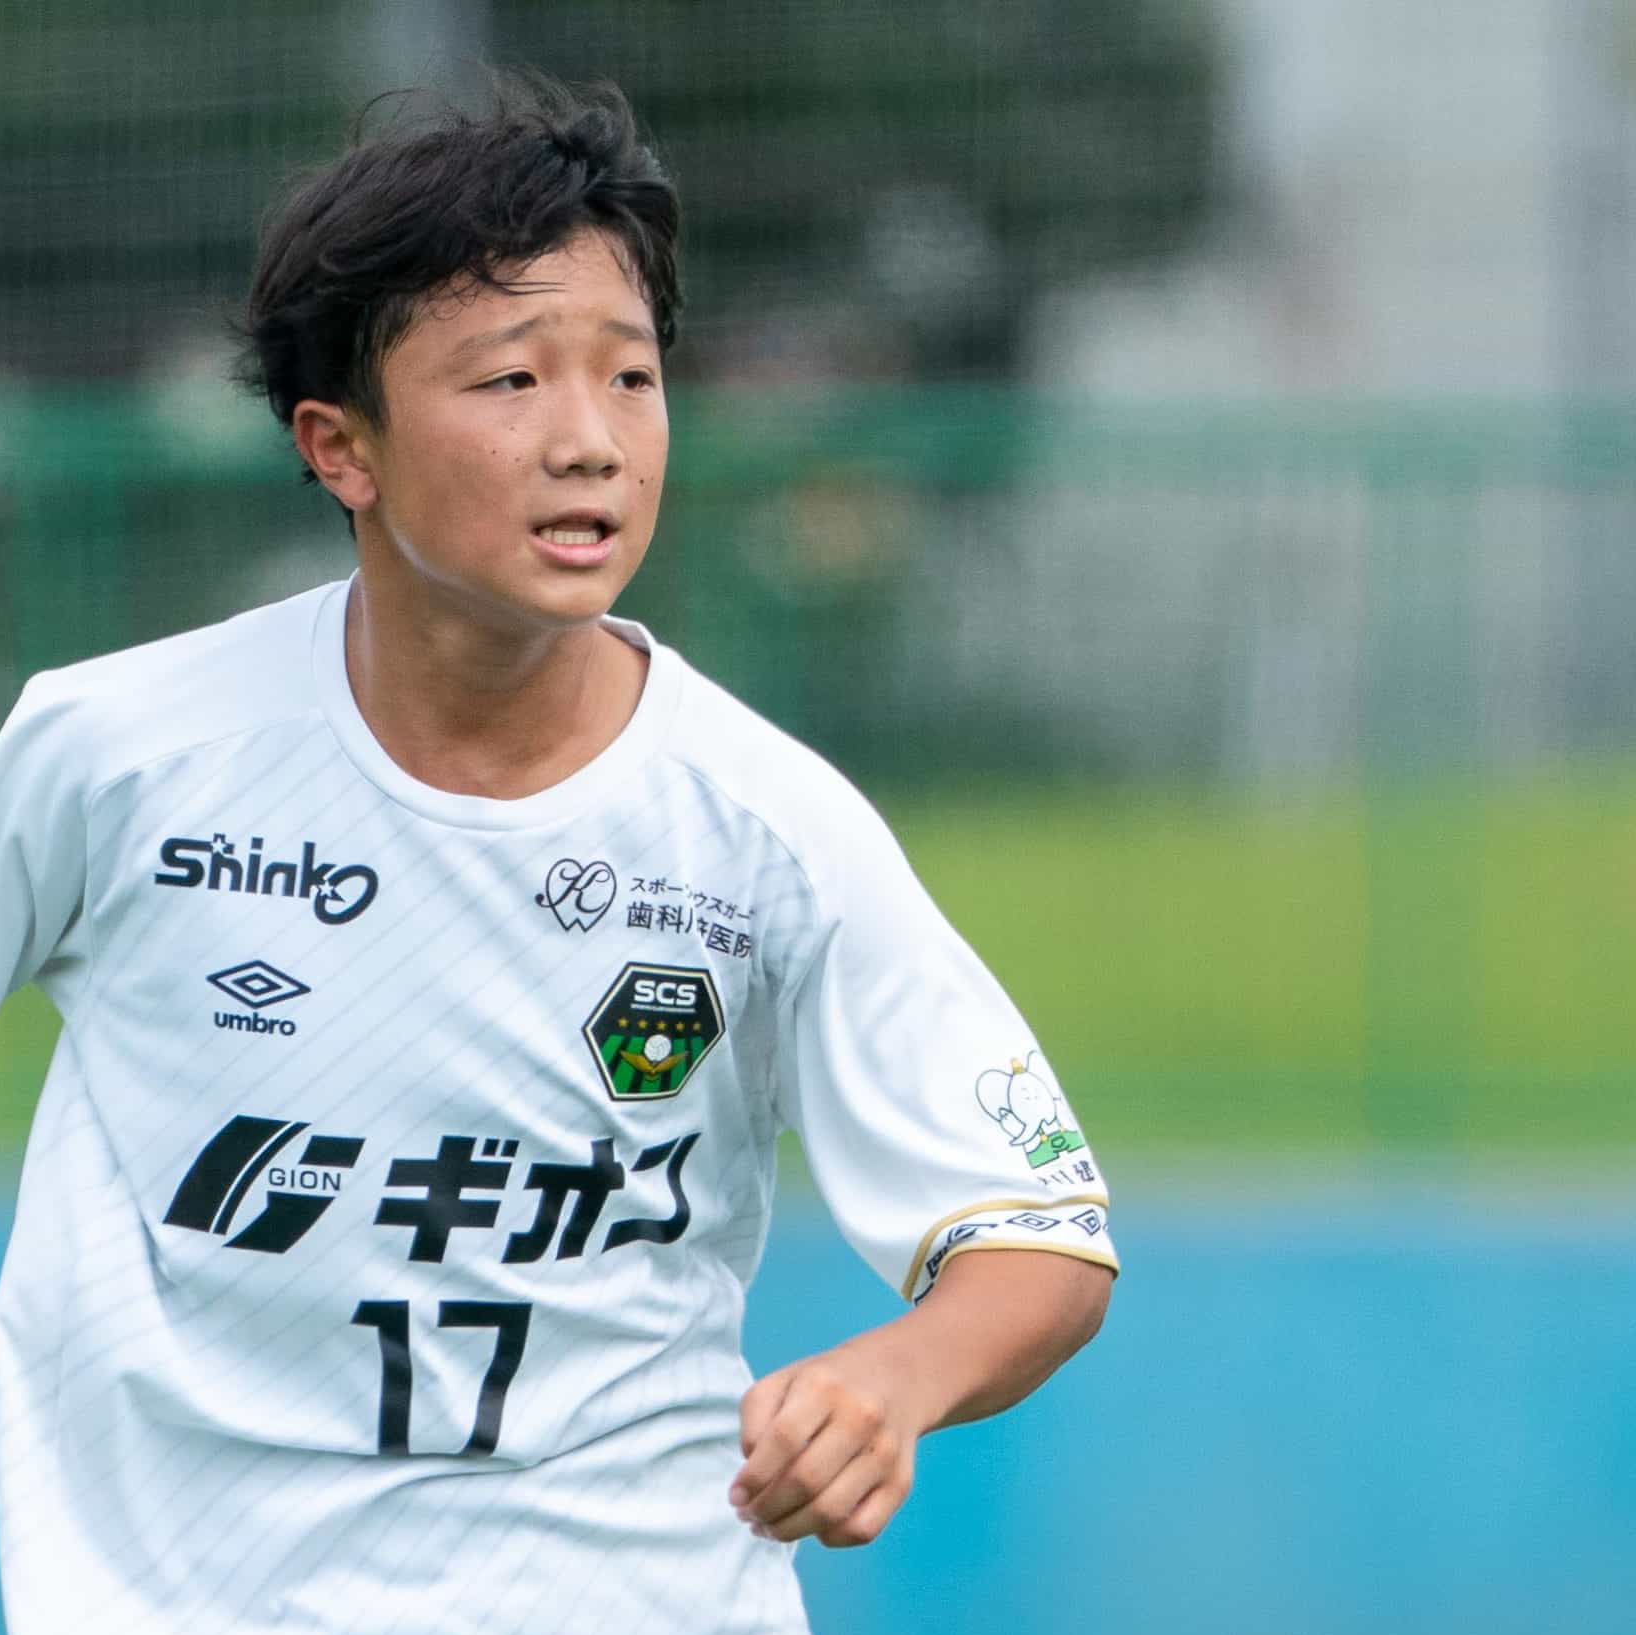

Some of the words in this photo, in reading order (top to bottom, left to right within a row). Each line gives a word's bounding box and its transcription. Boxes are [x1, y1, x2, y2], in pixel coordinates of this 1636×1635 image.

[633, 979, 697, 1006] SCS
[214, 1011, 297, 1037] umbro
[267, 1167, 342, 1191] GION
[373, 1131, 703, 1264] ギオン
[351, 1299, 533, 1458] 17
